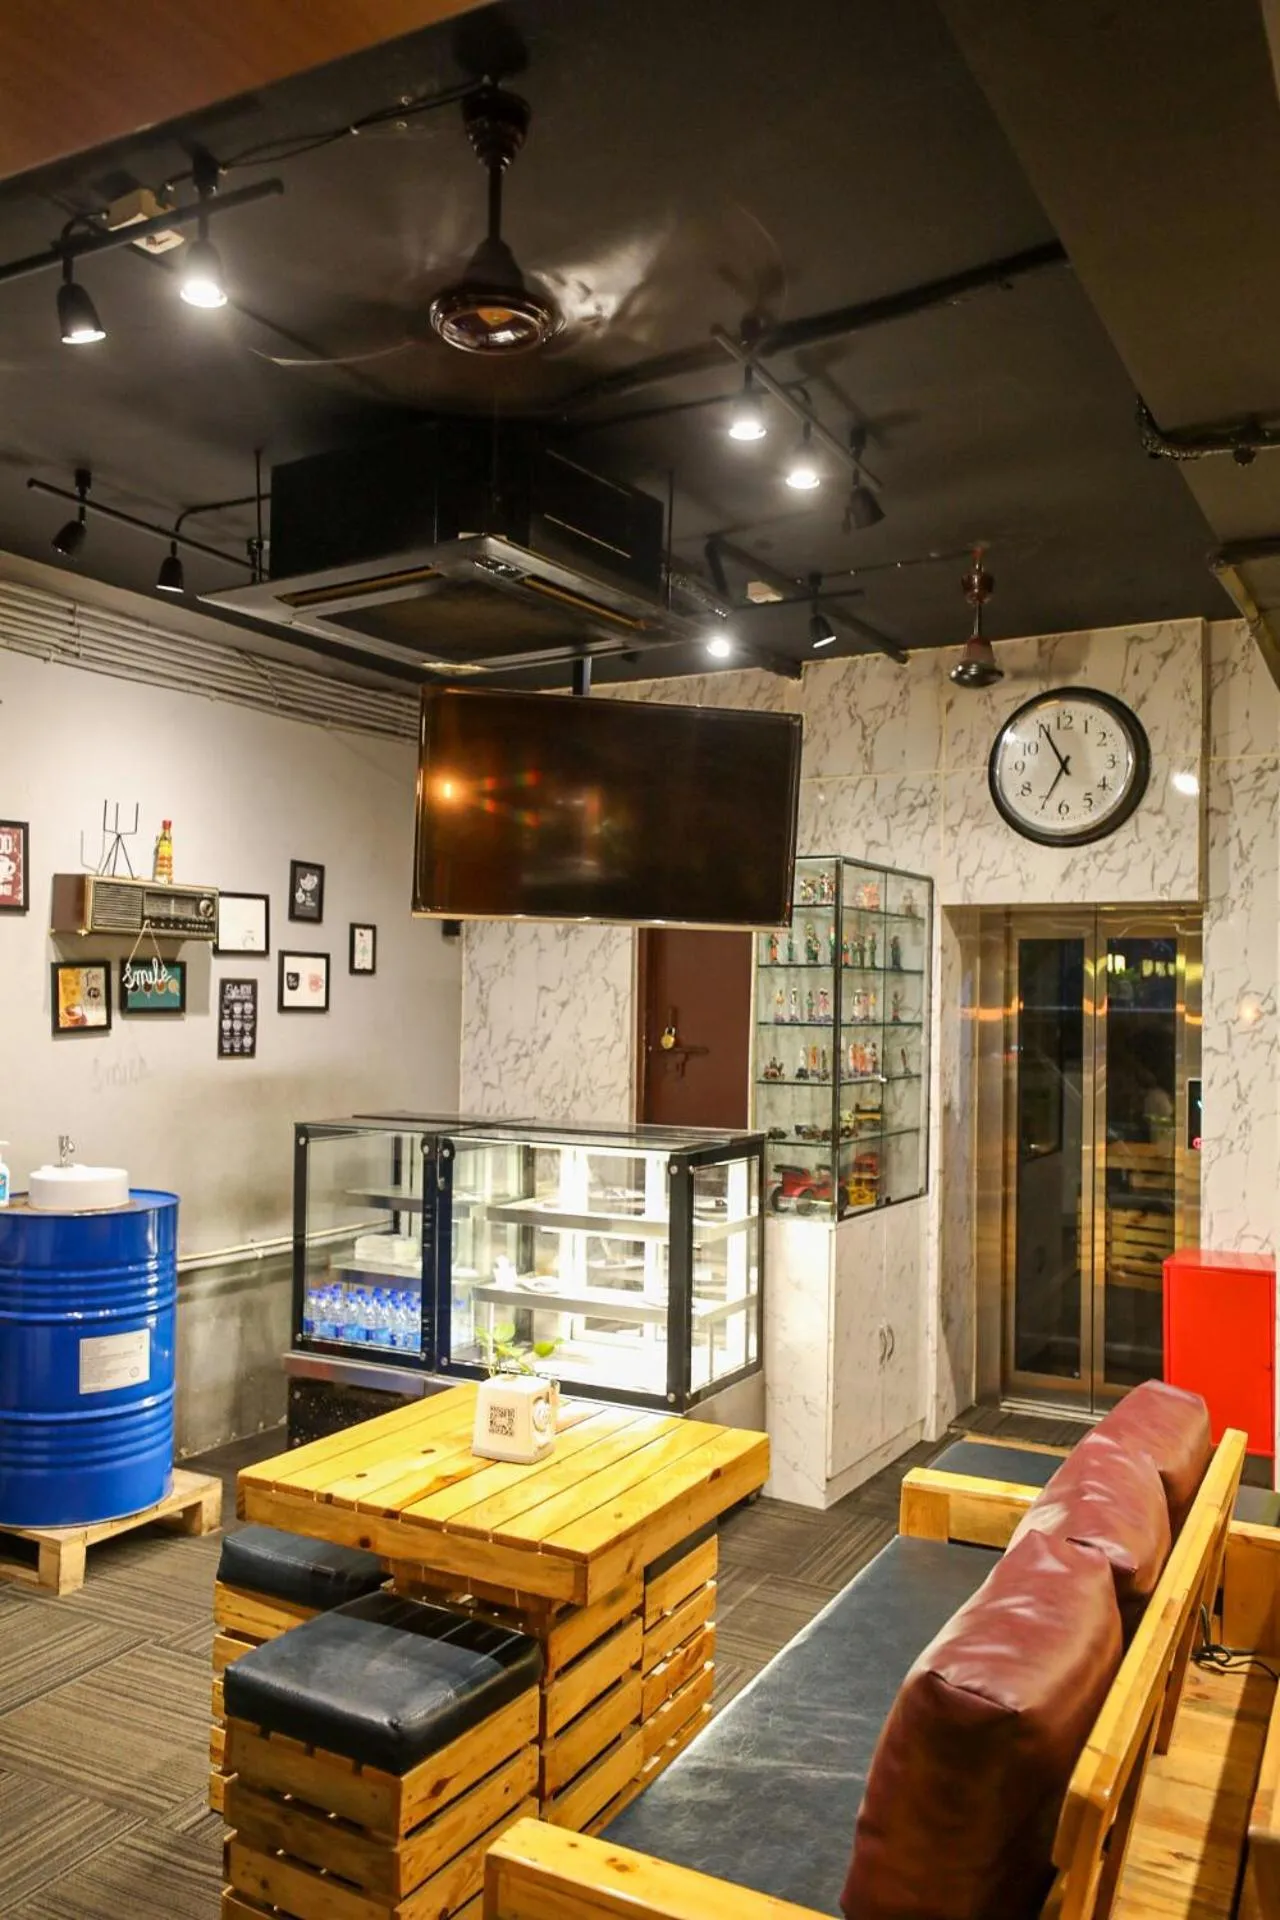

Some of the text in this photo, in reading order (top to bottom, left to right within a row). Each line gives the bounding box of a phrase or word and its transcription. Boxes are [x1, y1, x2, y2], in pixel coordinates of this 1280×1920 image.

[1056, 714, 1073, 731] 12
[1083, 718, 1090, 734] 1
[1096, 731, 1108, 747] 2
[1023, 741, 1039, 756] 10
[1014, 760, 1026, 776] 9
[1106, 754, 1116, 769] 3
[1020, 780, 1033, 797] 8
[1097, 775, 1109, 791] 4
[1057, 799, 1070, 816] 6
[1083, 792, 1094, 809] 5
